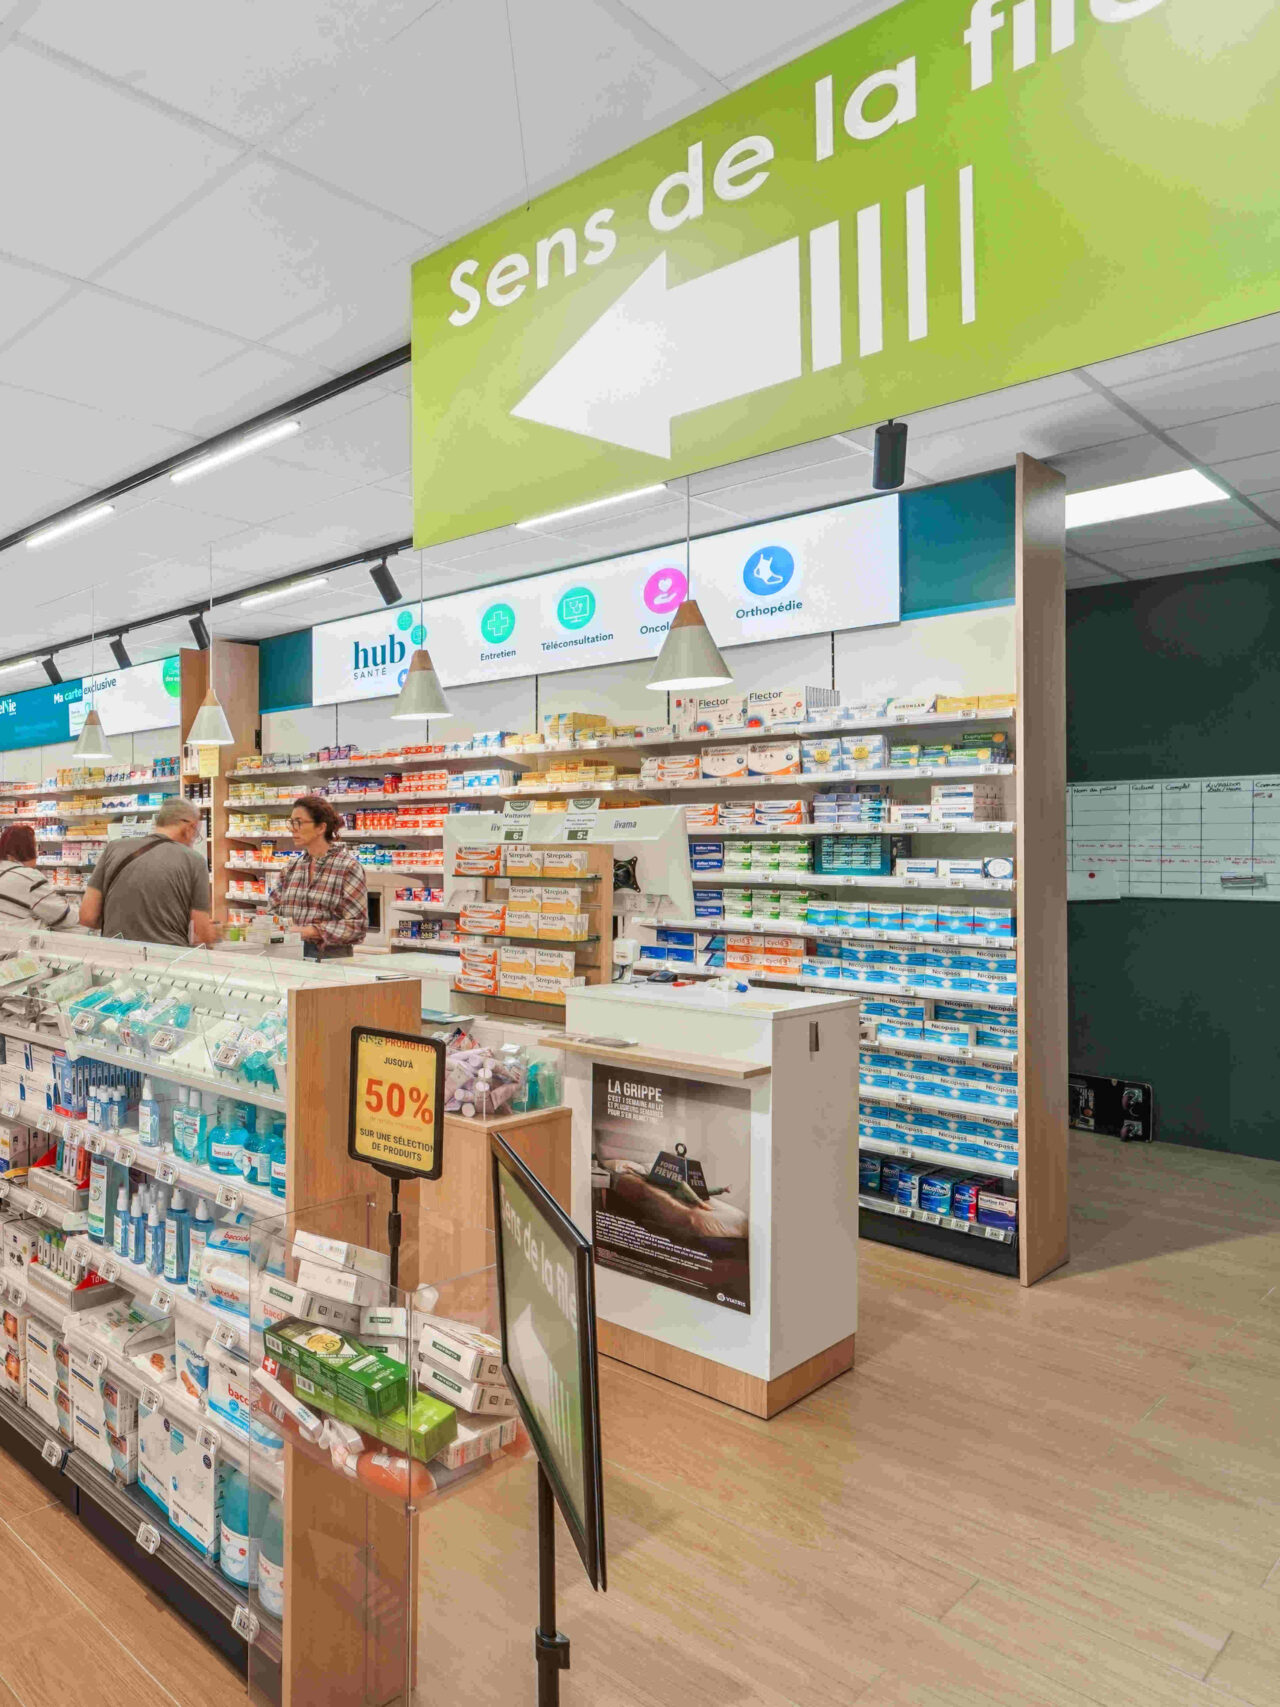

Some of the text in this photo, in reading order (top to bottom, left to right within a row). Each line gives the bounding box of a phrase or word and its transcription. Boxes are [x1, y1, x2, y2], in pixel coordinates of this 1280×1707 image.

[446, 0, 1164, 327] Sens de la fil
[736, 600, 803, 619] Orthopédie
[640, 621, 670, 635] Oncol
[541, 633, 614, 651] Téléconsultation
[353, 634, 406, 670] hub
[480, 649, 517, 661] Entretien
[353, 667, 387, 680] SANTÉ
[53, 677, 117, 704] Ma carte exclusive
[749, 691, 783, 701] Flector
[698, 698, 729, 707] Flector
[889, 944, 917, 953] Nicopass
[976, 950, 1007, 959] Nicopass
[848, 962, 875, 970] Nicopass
[977, 972, 1008, 981] Nicopass
[944, 1000, 973, 1009] Nicopass
[989, 1026, 1018, 1035] Nicopass
[384, 1057, 414, 1069] JUSQU'À
[982, 1062, 1012, 1072] Nicopass
[608, 1079, 621, 1094] LA
[940, 1077, 970, 1088] Nicopass
[365, 1078, 434, 1125] 50%
[608, 1094, 621, 1102] C'EST
[982, 1117, 1013, 1128] Nicopass
[360, 1128, 375, 1138] SUR
[376, 1132, 392, 1143] UNE
[938, 1131, 968, 1143] Nicopass
[372, 1141, 422, 1161] DE PRODUITS
[500, 1183, 521, 1246] Sens
[523, 1222, 538, 1272] de
[541, 1240, 554, 1297] la
